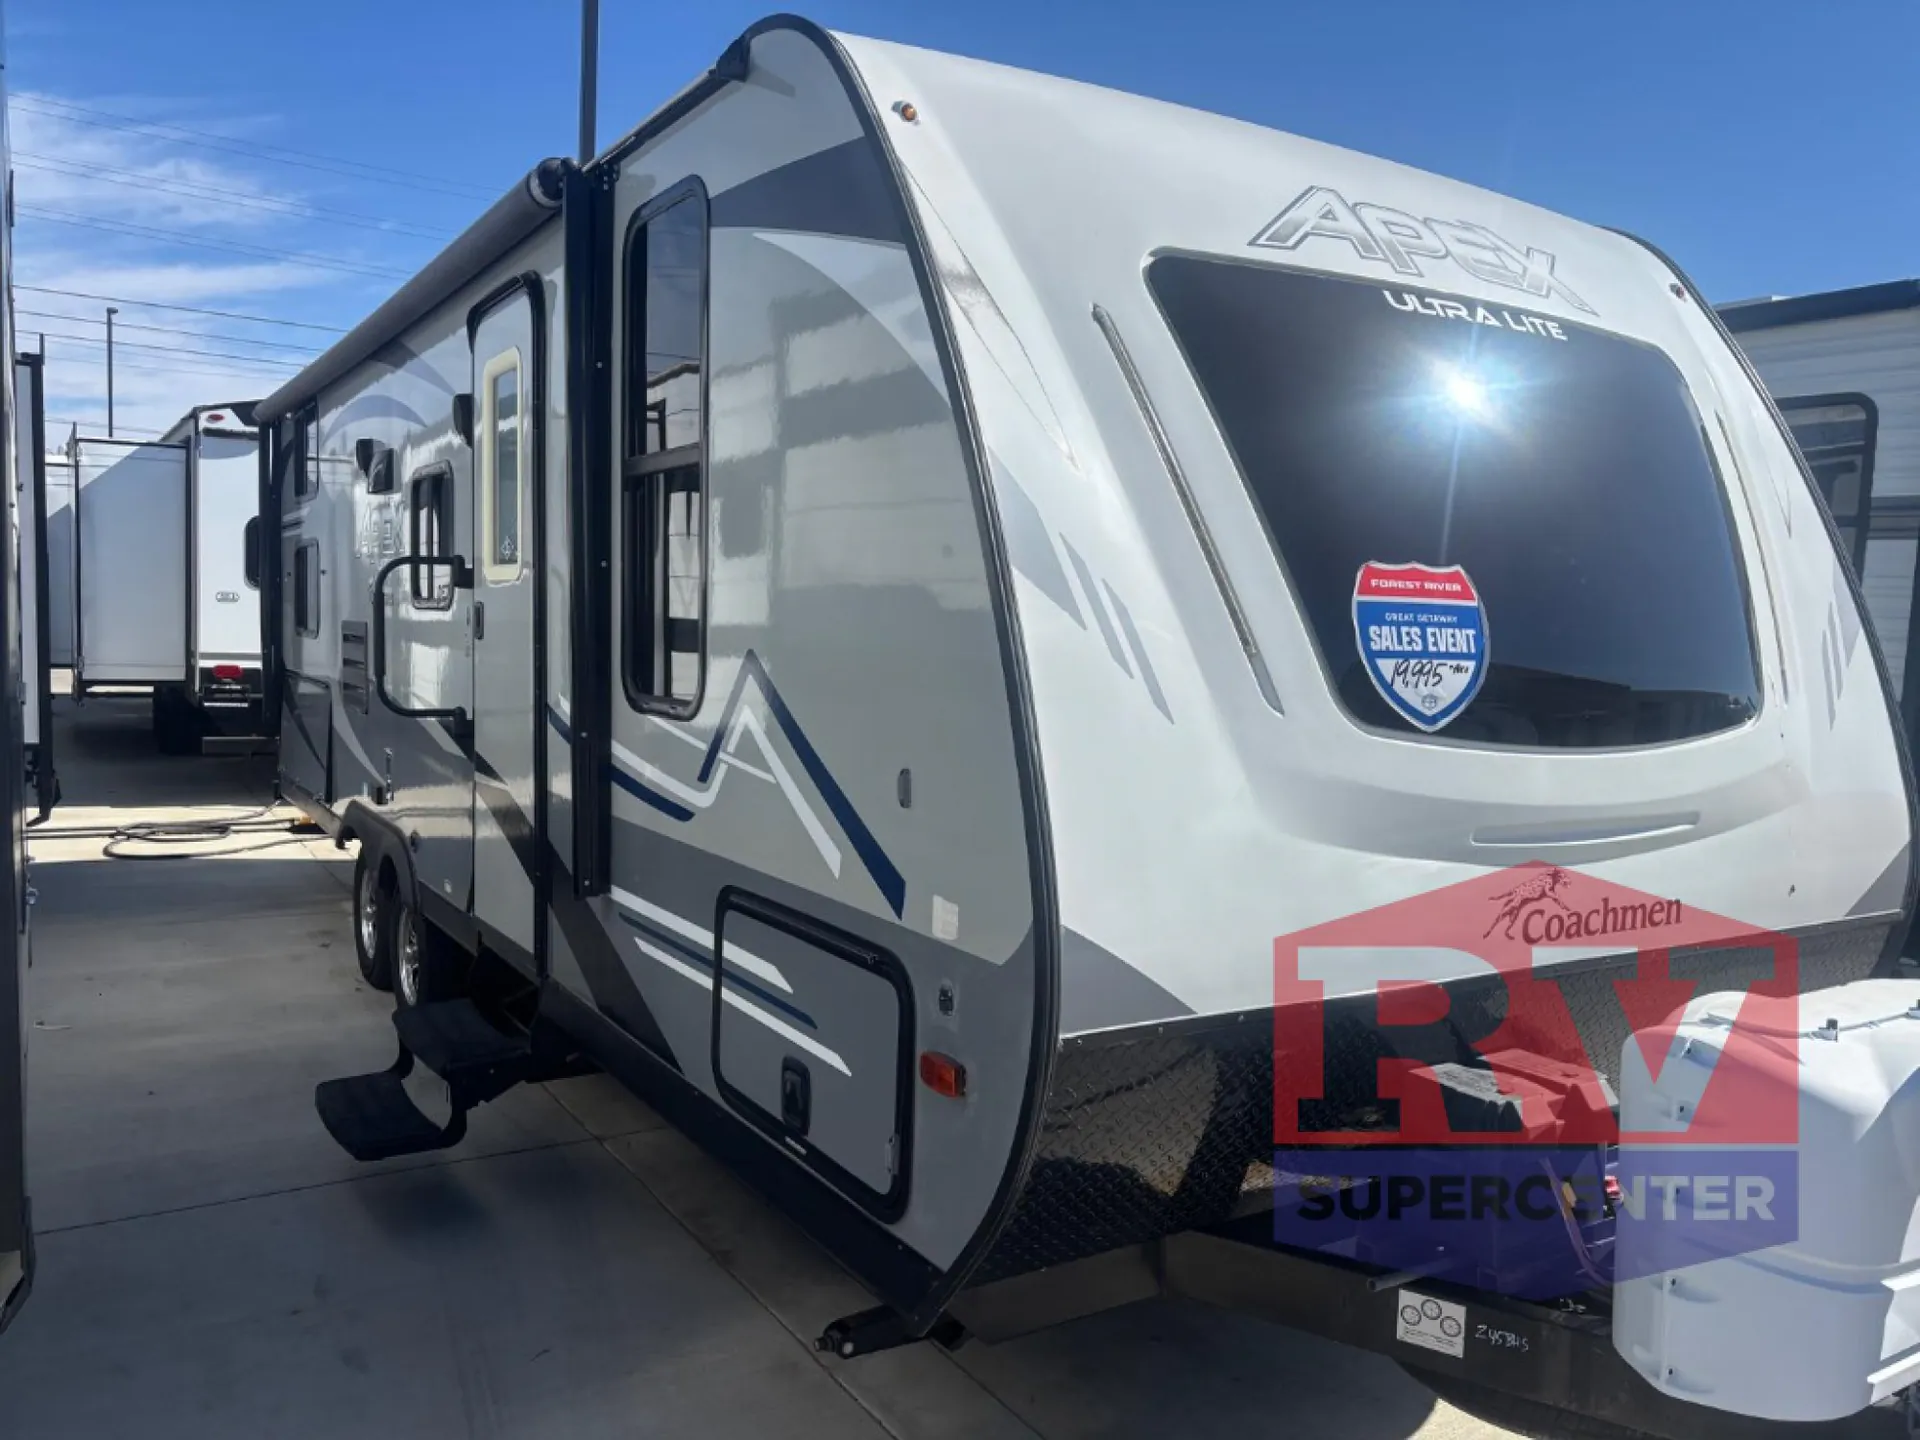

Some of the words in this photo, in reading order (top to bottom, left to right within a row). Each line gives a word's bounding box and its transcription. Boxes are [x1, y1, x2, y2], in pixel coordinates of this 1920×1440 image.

[1246, 185, 1600, 317] APEX
[1382, 289, 1502, 328] ULTRA
[1502, 310, 1569, 341] LITE
[1370, 578, 1422, 590] FOREST
[1424, 581, 1462, 592] RIVER
[1368, 626, 1423, 652] SALES
[1426, 628, 1477, 653] EVENT
[1522, 896, 1682, 944] Coachmen
